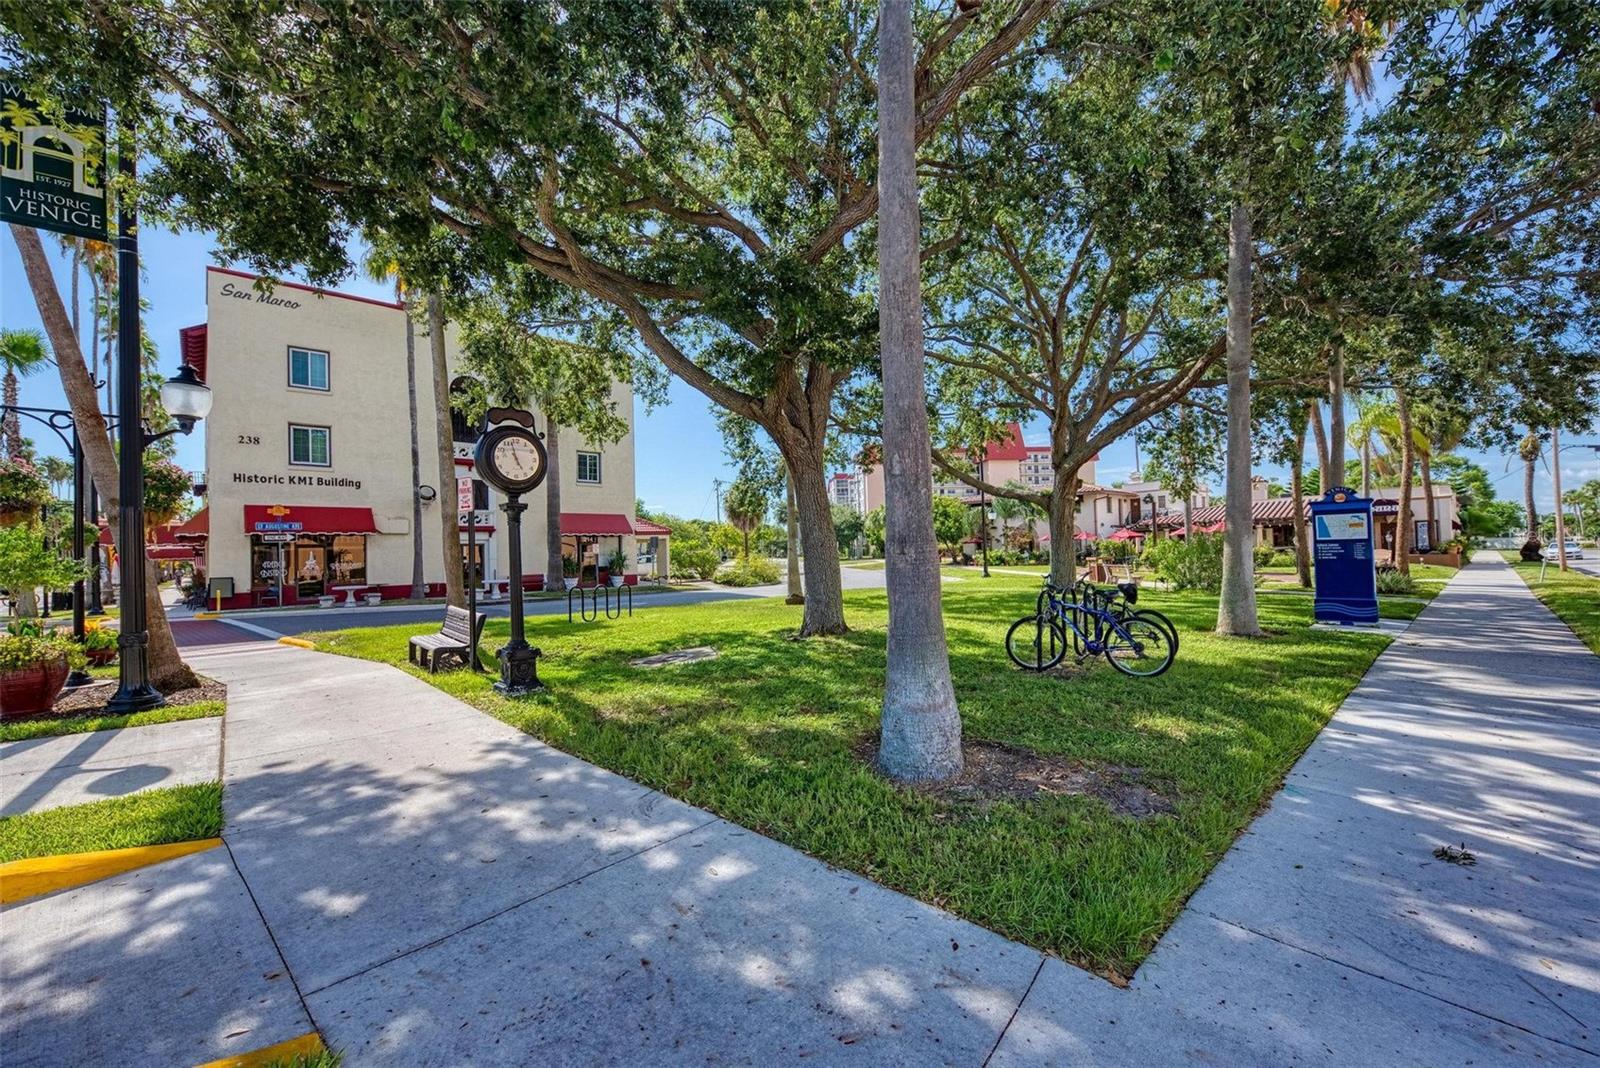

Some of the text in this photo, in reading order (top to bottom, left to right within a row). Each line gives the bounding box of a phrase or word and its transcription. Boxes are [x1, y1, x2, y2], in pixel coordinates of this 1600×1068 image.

[35, 174, 72, 188] EST. 1927
[19, 187, 91, 211] HISTORIC
[5, 195, 102, 230] VENICE
[220, 282, 302, 309] San Marco
[238, 434, 260, 445] 238
[233, 473, 361, 489] Historic KMI Building
